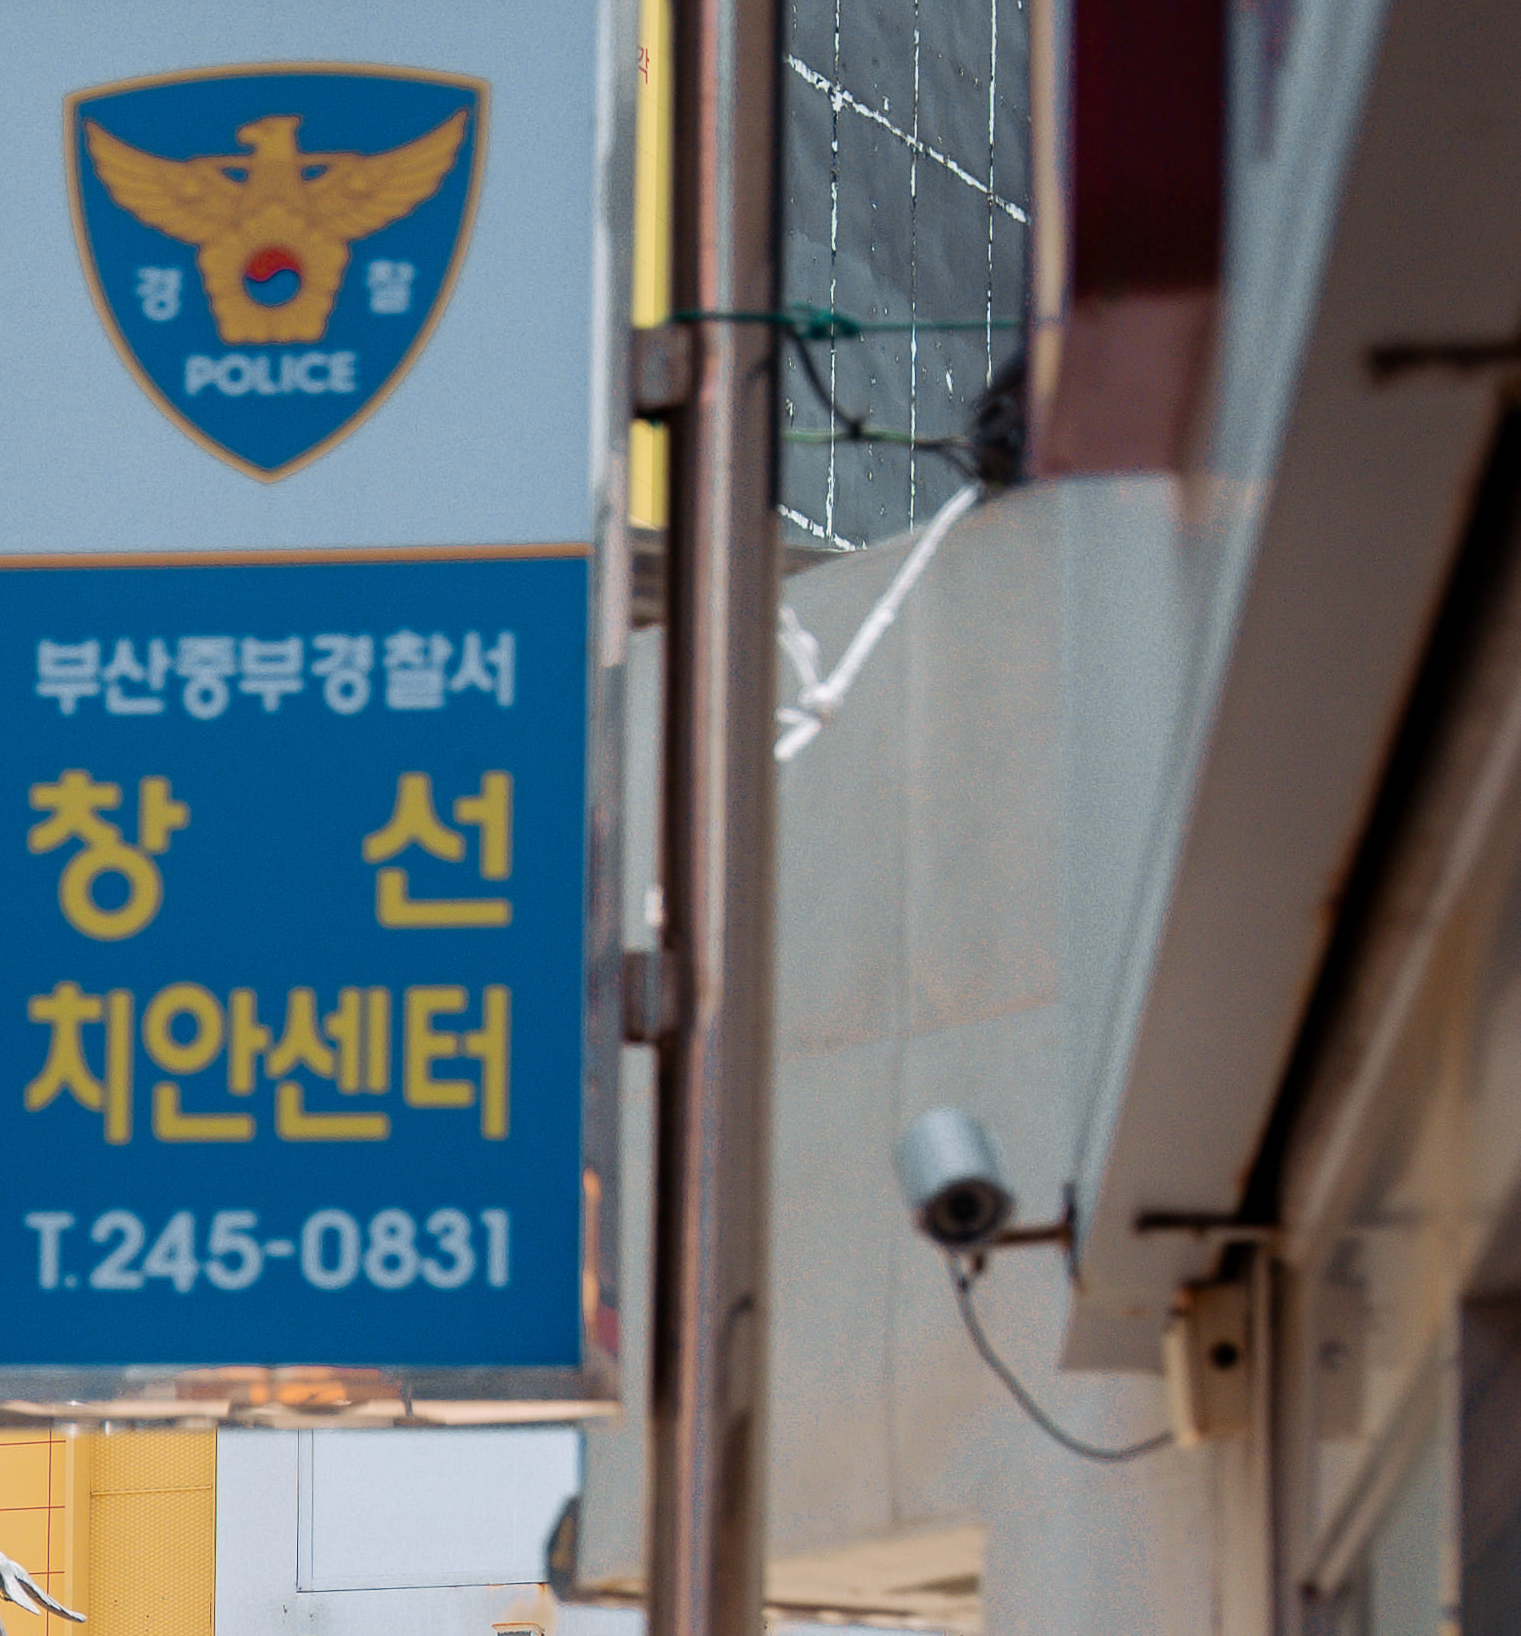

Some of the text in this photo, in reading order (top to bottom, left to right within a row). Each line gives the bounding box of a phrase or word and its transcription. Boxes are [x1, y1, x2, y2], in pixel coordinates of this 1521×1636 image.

[186, 354, 357, 396] POLICE
[36, 631, 516, 719] 부산중부경찰서
[24, 981, 510, 1145] 치안센터
[25, 1209, 511, 1292] T.245-0831
